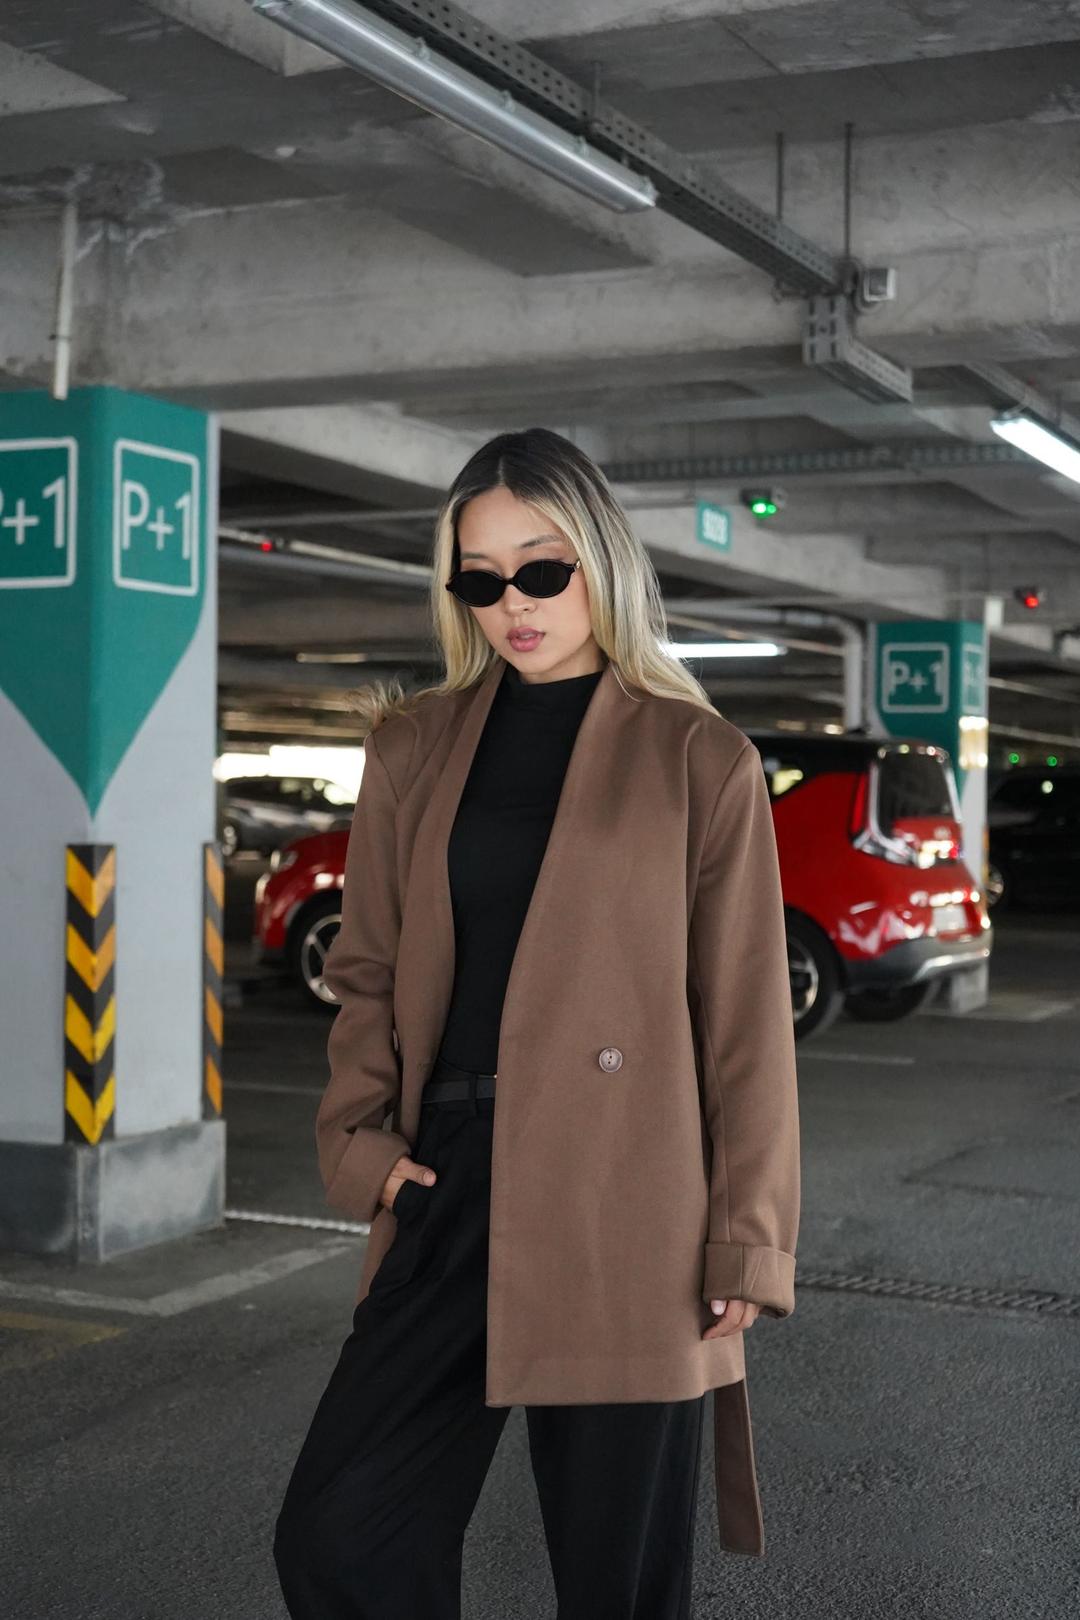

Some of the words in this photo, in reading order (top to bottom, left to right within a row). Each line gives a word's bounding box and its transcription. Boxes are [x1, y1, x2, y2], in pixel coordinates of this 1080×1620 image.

[0, 475, 66, 549] +1
[121, 478, 192, 561] P+1
[887, 660, 944, 696] P+1
